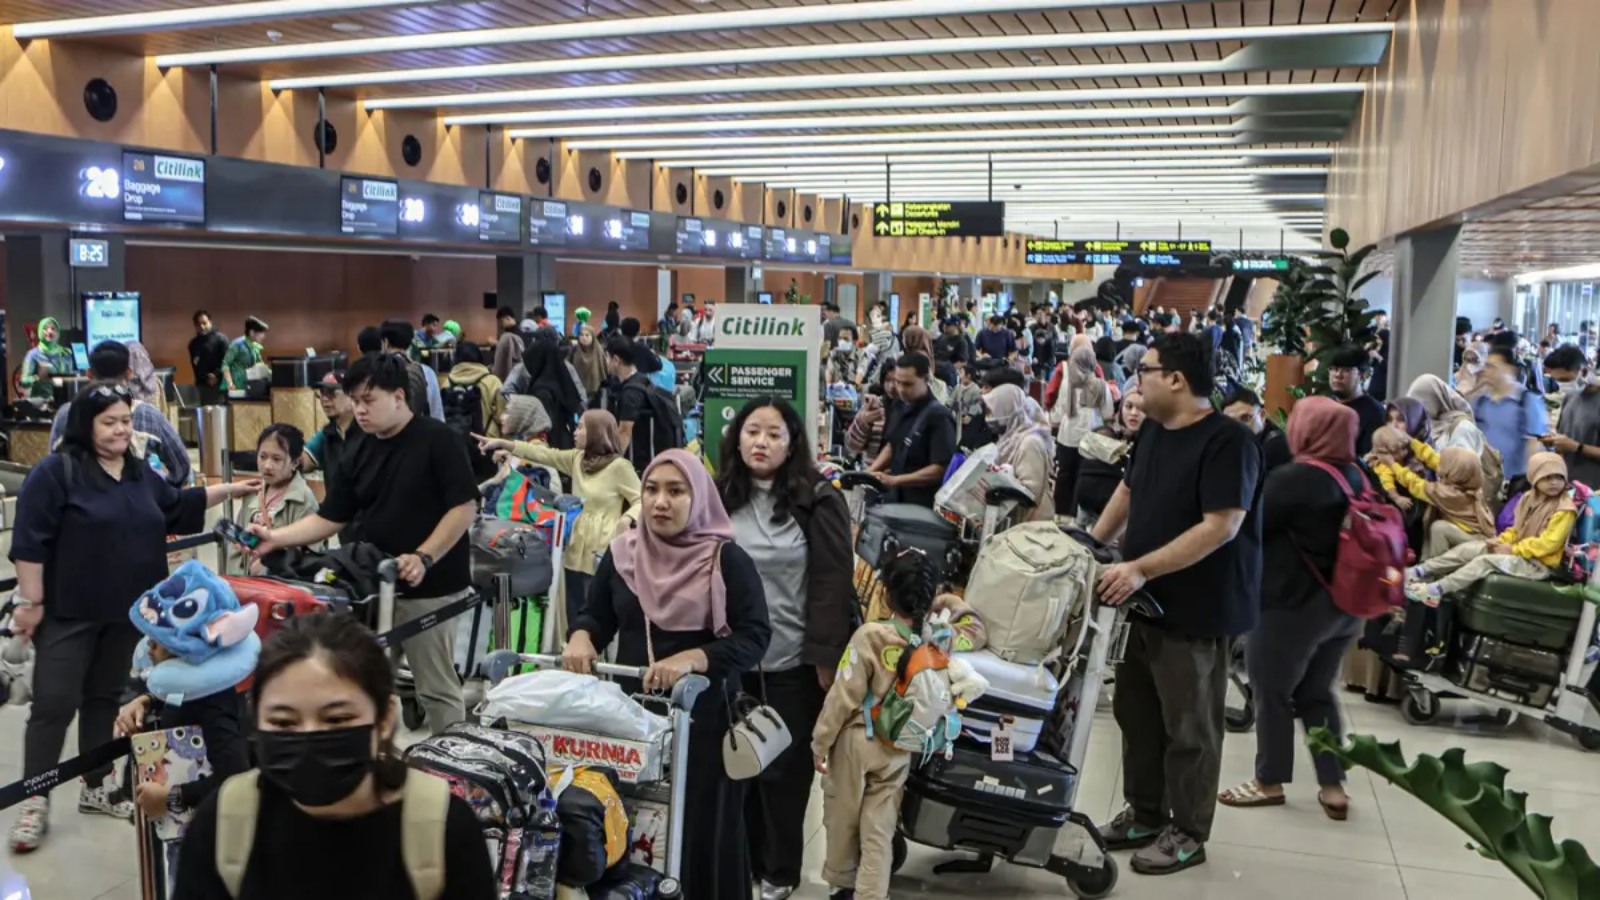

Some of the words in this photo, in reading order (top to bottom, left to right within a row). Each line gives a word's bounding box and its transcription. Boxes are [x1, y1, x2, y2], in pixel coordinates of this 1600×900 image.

[156, 161, 201, 178] Citilink
[124, 179, 161, 195] Baggage
[364, 183, 396, 198] Citilink
[124, 192, 144, 205] Drop
[79, 244, 104, 262] 8:25
[722, 316, 806, 336] Citilink
[731, 366, 793, 377] PASSENGER
[731, 376, 775, 386] SERVICE
[553, 735, 641, 766] KURNIA
